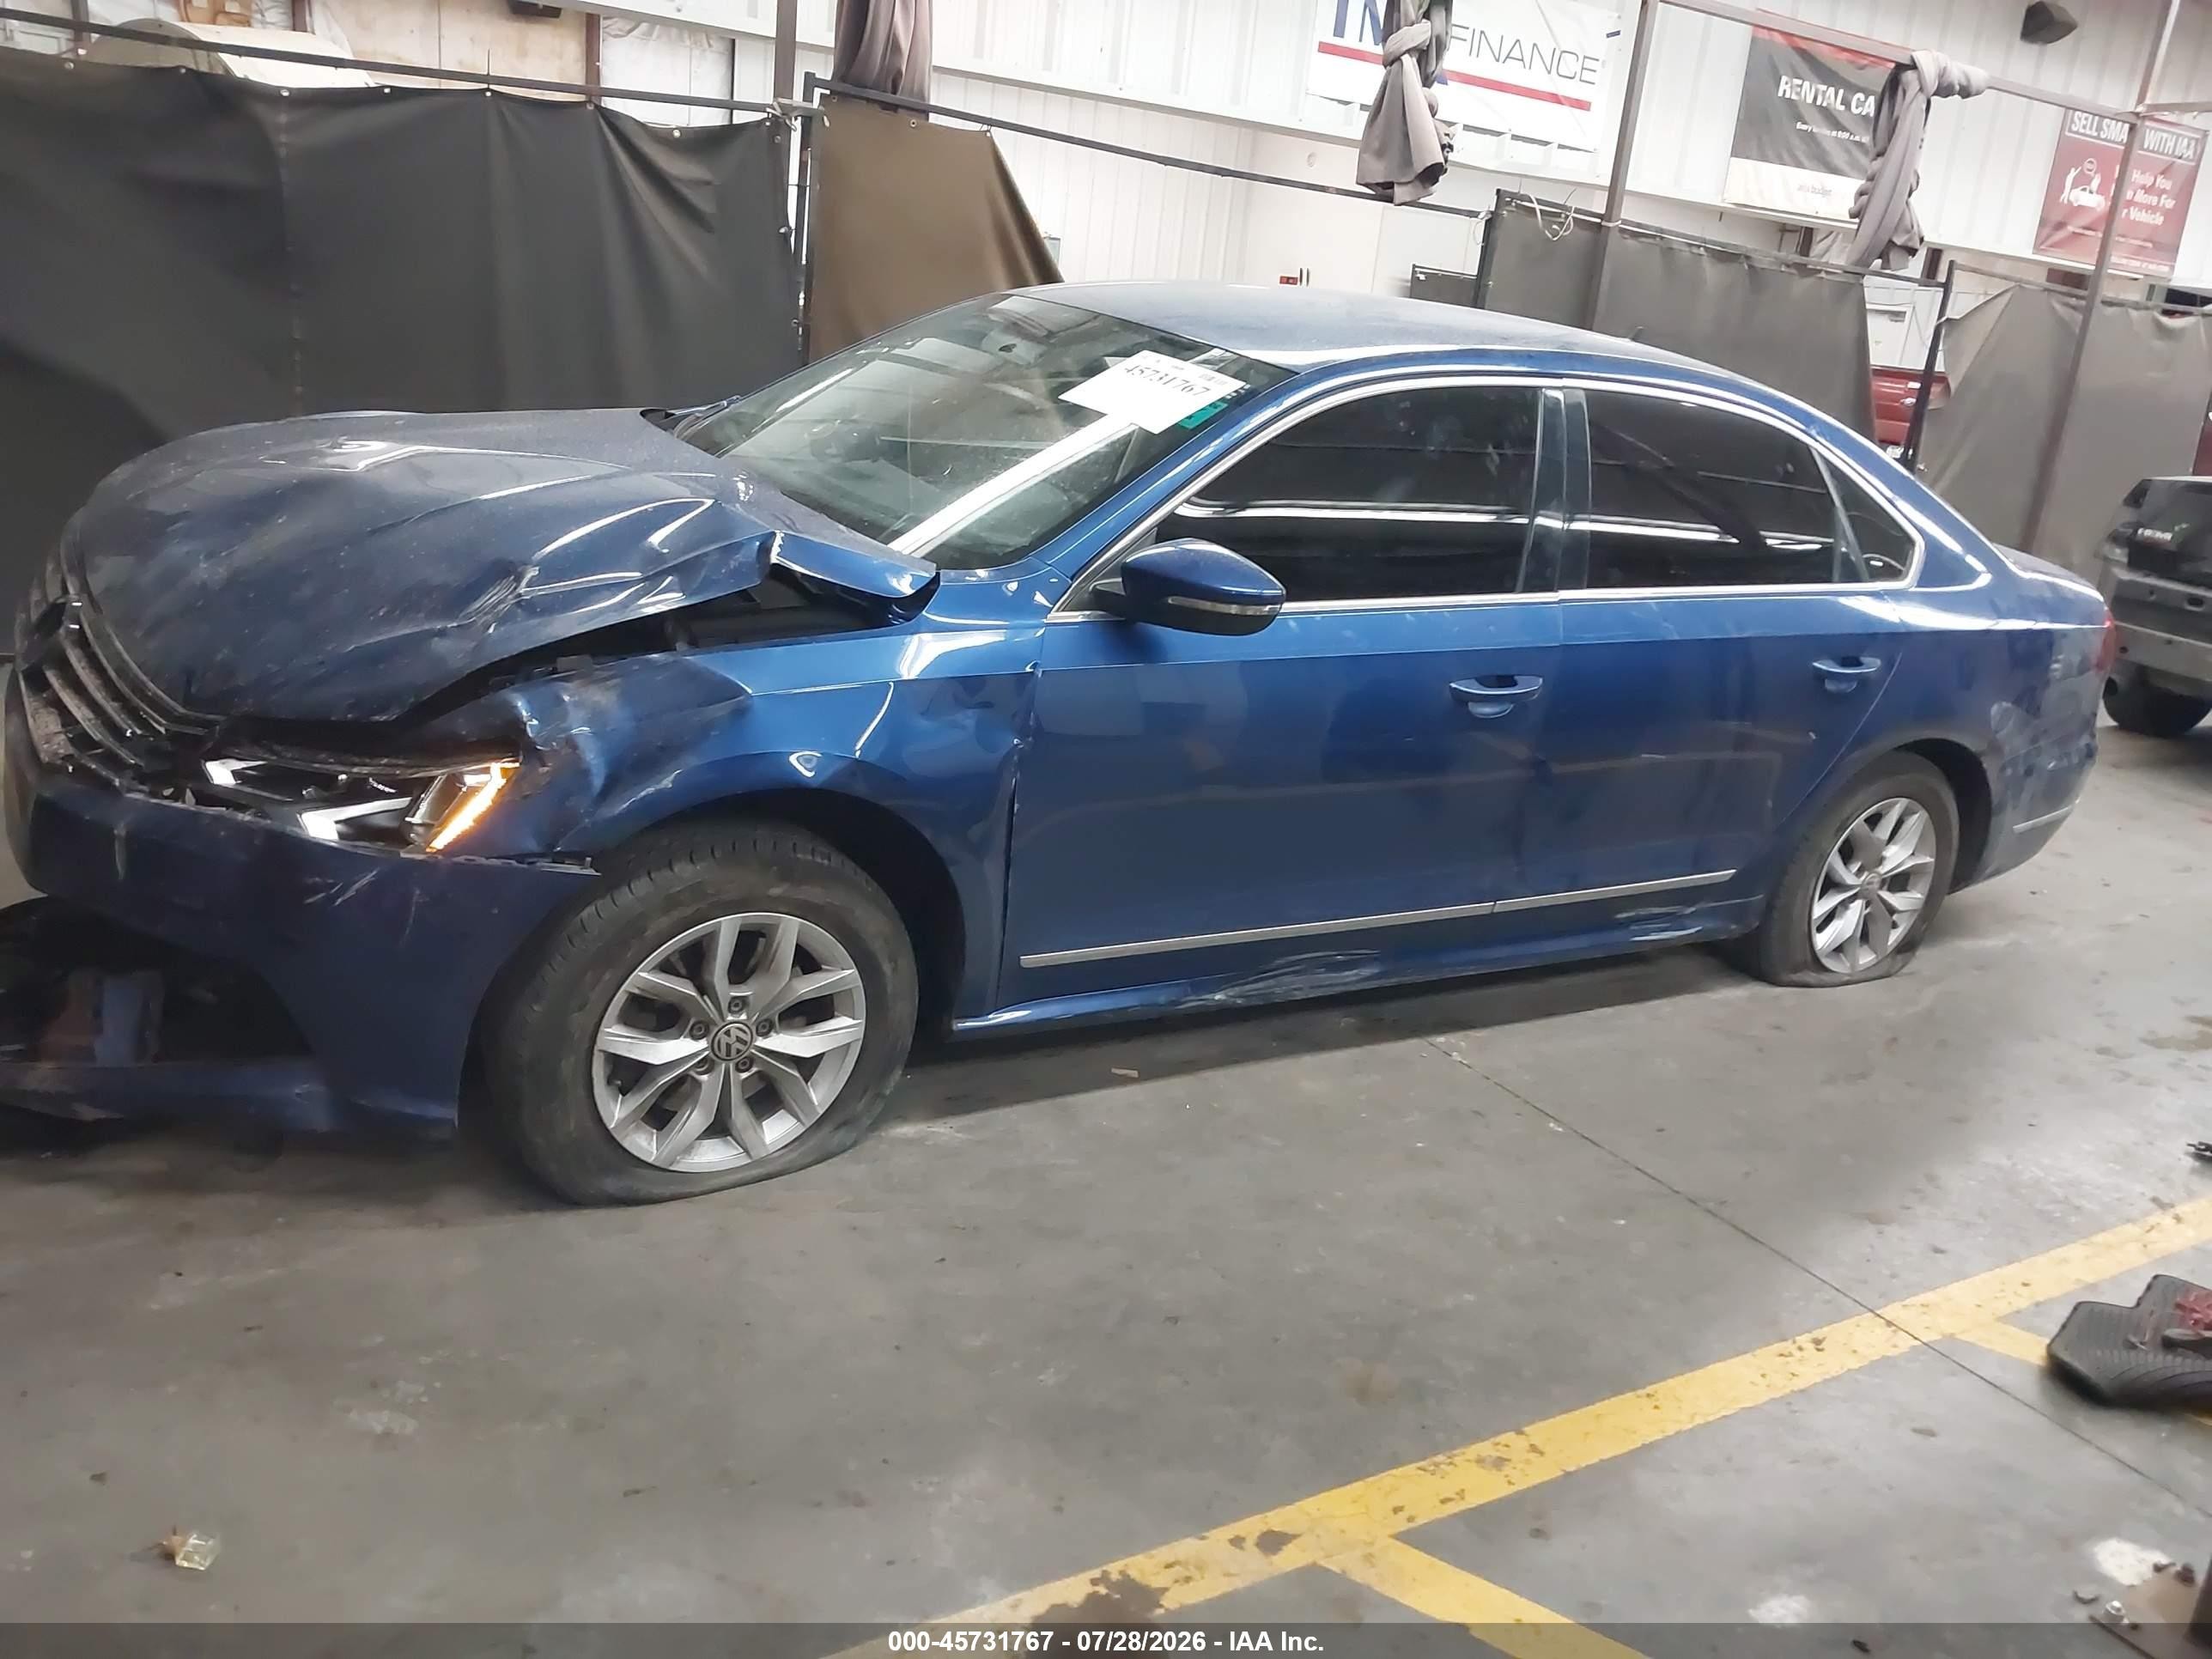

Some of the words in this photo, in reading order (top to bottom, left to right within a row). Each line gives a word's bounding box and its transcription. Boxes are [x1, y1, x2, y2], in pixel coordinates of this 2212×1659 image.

[1451, 23, 1601, 85] FINANCE
[1778, 75, 1845, 110] RENTAL
[1850, 92, 1875, 117] CA
[2071, 111, 2099, 136] SELL
[2100, 118, 2130, 143] SMA
[2143, 128, 2175, 155] WITH
[2131, 169, 2154, 187] Help
[2155, 173, 2172, 190] You
[2133, 189, 2158, 206] More
[2160, 194, 2177, 209] For
[2130, 206, 2165, 226] Vehicle
